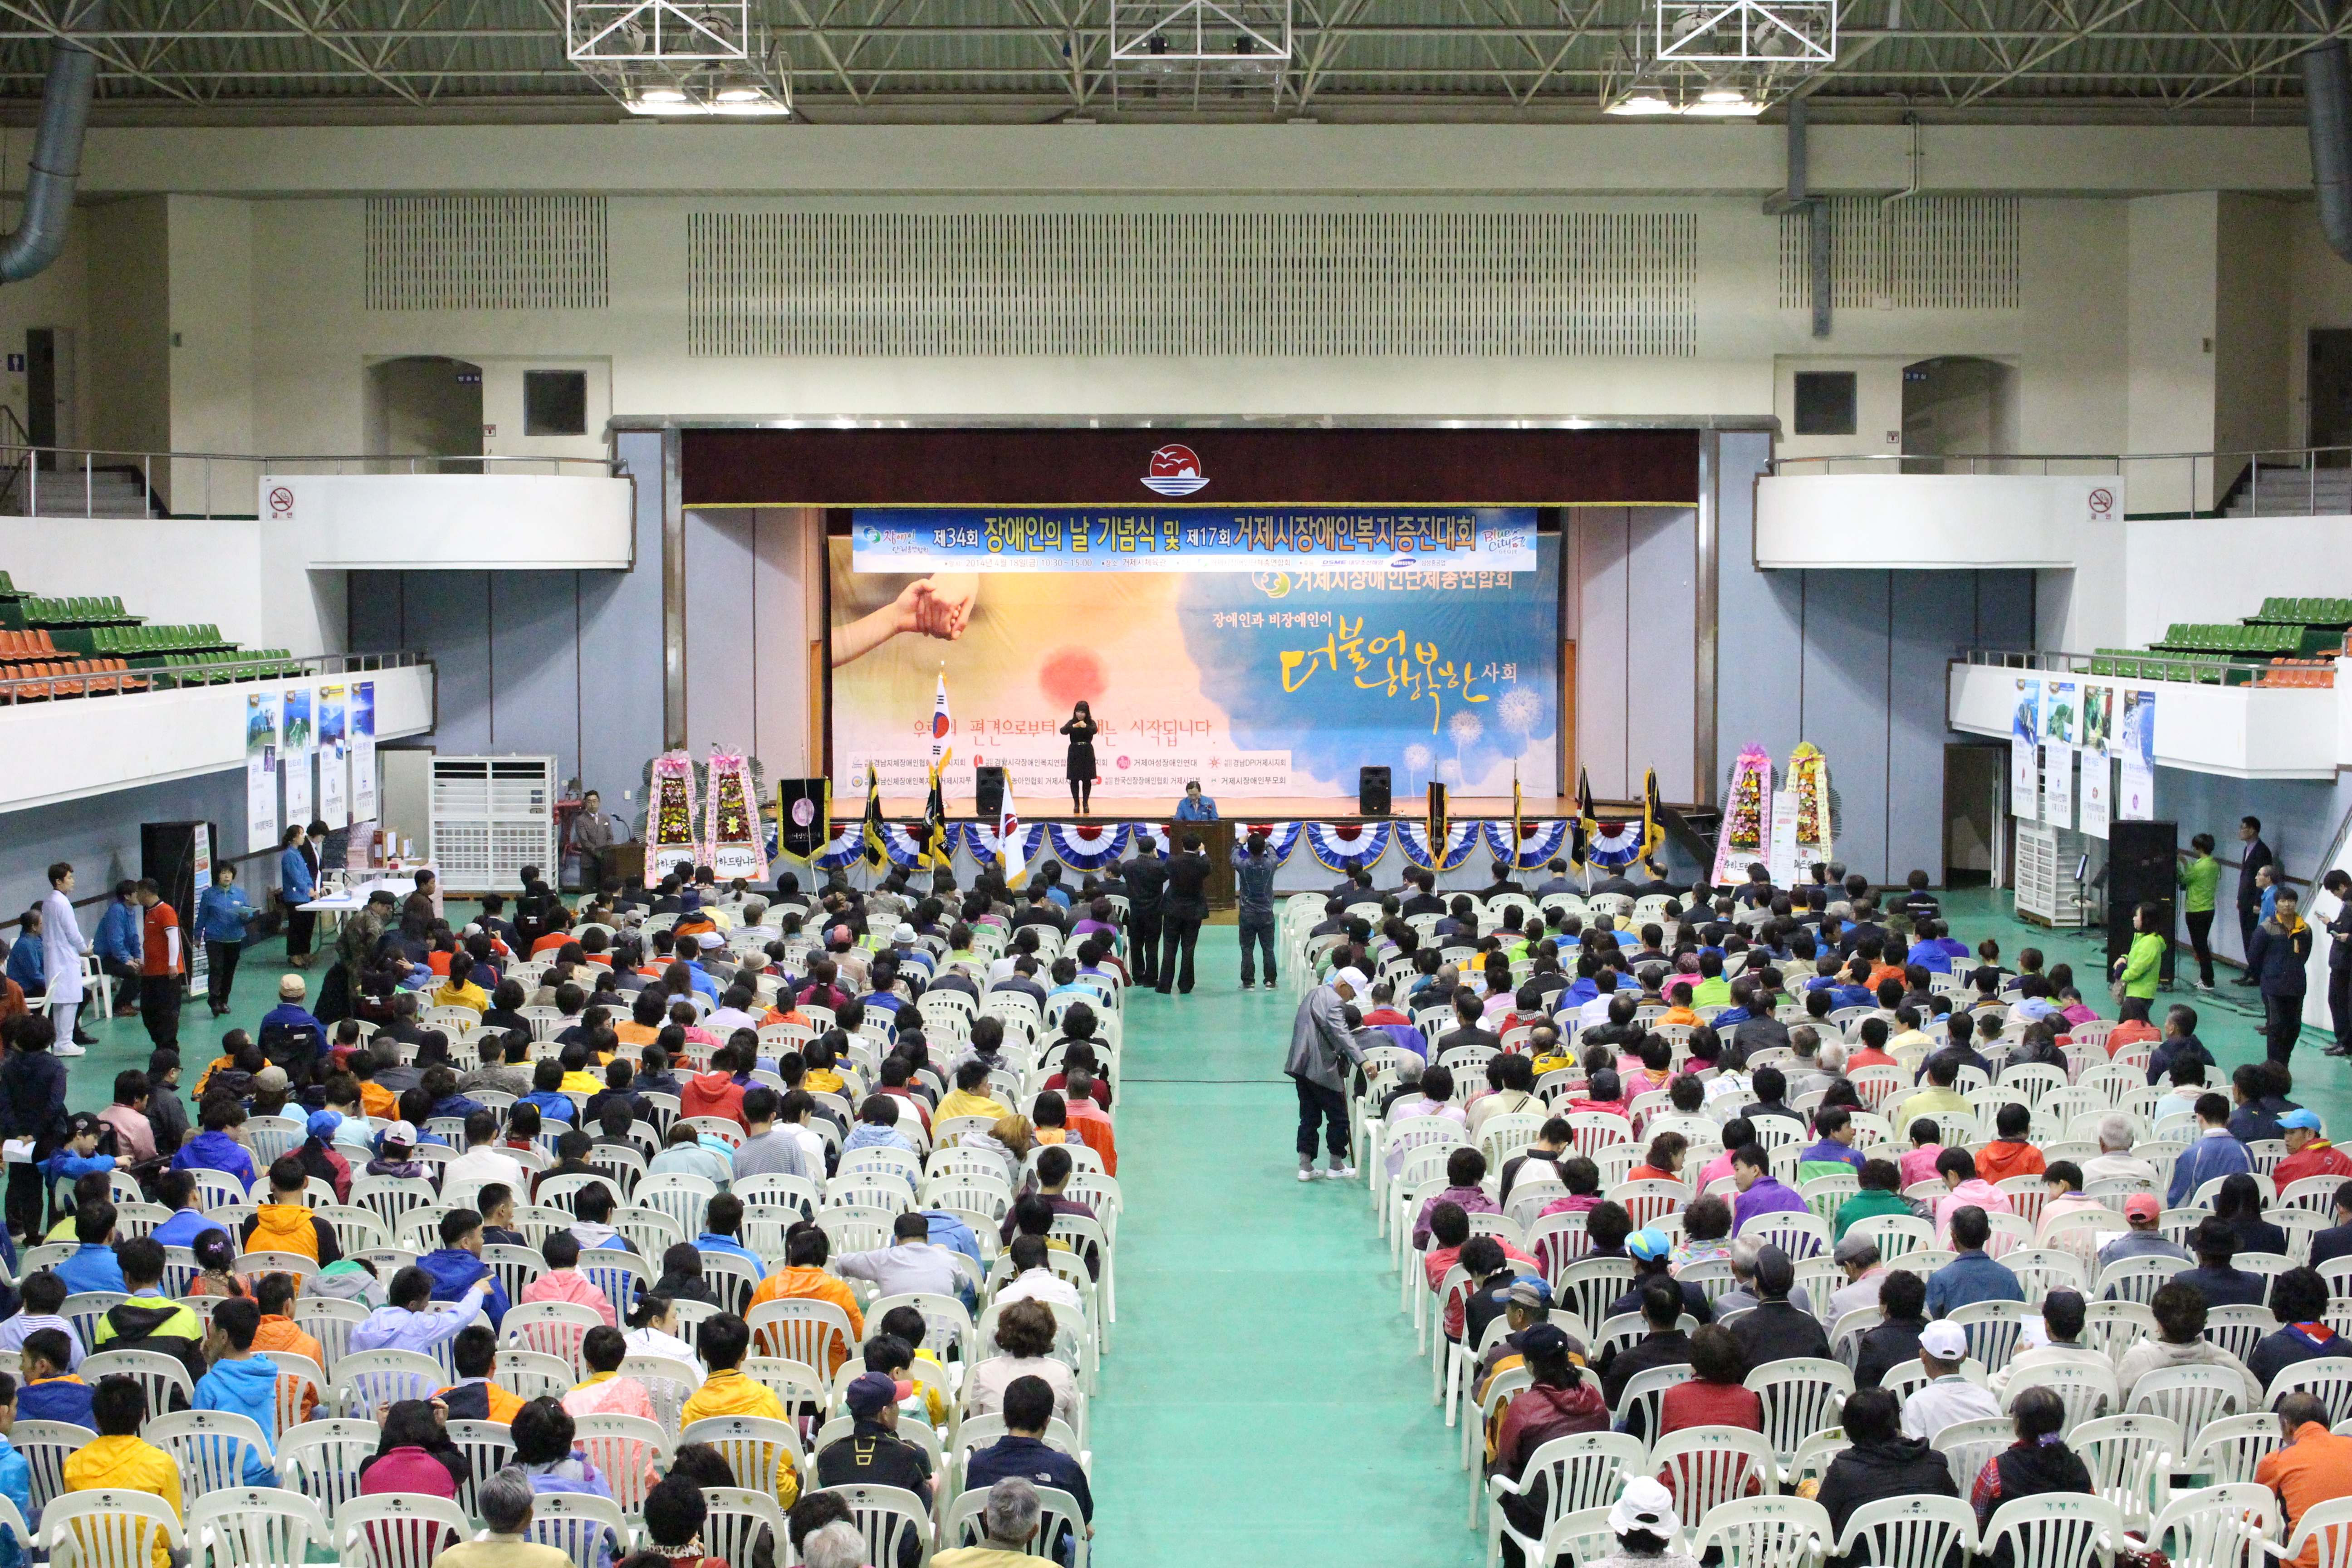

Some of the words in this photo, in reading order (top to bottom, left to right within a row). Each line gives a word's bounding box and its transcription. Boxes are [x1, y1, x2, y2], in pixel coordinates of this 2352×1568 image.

[933, 527, 979, 548] 제34회
[983, 516, 1062, 553] 장애인의
[1069, 516, 1090, 552] 날
[1096, 516, 1156, 552] 기념식
[1163, 519, 1181, 552] 및
[1186, 527, 1231, 547] 제17회
[1233, 515, 1476, 552] 거제시장애인복지증진대회
[1481, 527, 1511, 543] Blue
[1488, 536, 1513, 552] City
[966, 559, 992, 567] 2014년
[995, 559, 1007, 567] 4월
[1009, 559, 1039, 568] 18일(금)
[1122, 559, 1166, 567] 거제시체육관
[1210, 559, 1291, 567] 거제시장애인단체총연합회
[1212, 612, 1264, 628] 장애인과
[1269, 611, 1332, 628] 비장애인이
[1279, 614, 1406, 692] 더불어
[1481, 662, 1518, 684] 사회
[970, 718, 1055, 746] 편견으로부터
[995, 758, 1066, 767] 경남시각장애인복지연합
[1134, 758, 1197, 767] 거제여성장애인연대
[1114, 776, 1168, 785] 한국신장장애인협회
[1221, 776, 1286, 785] 거제시장애인부모회
